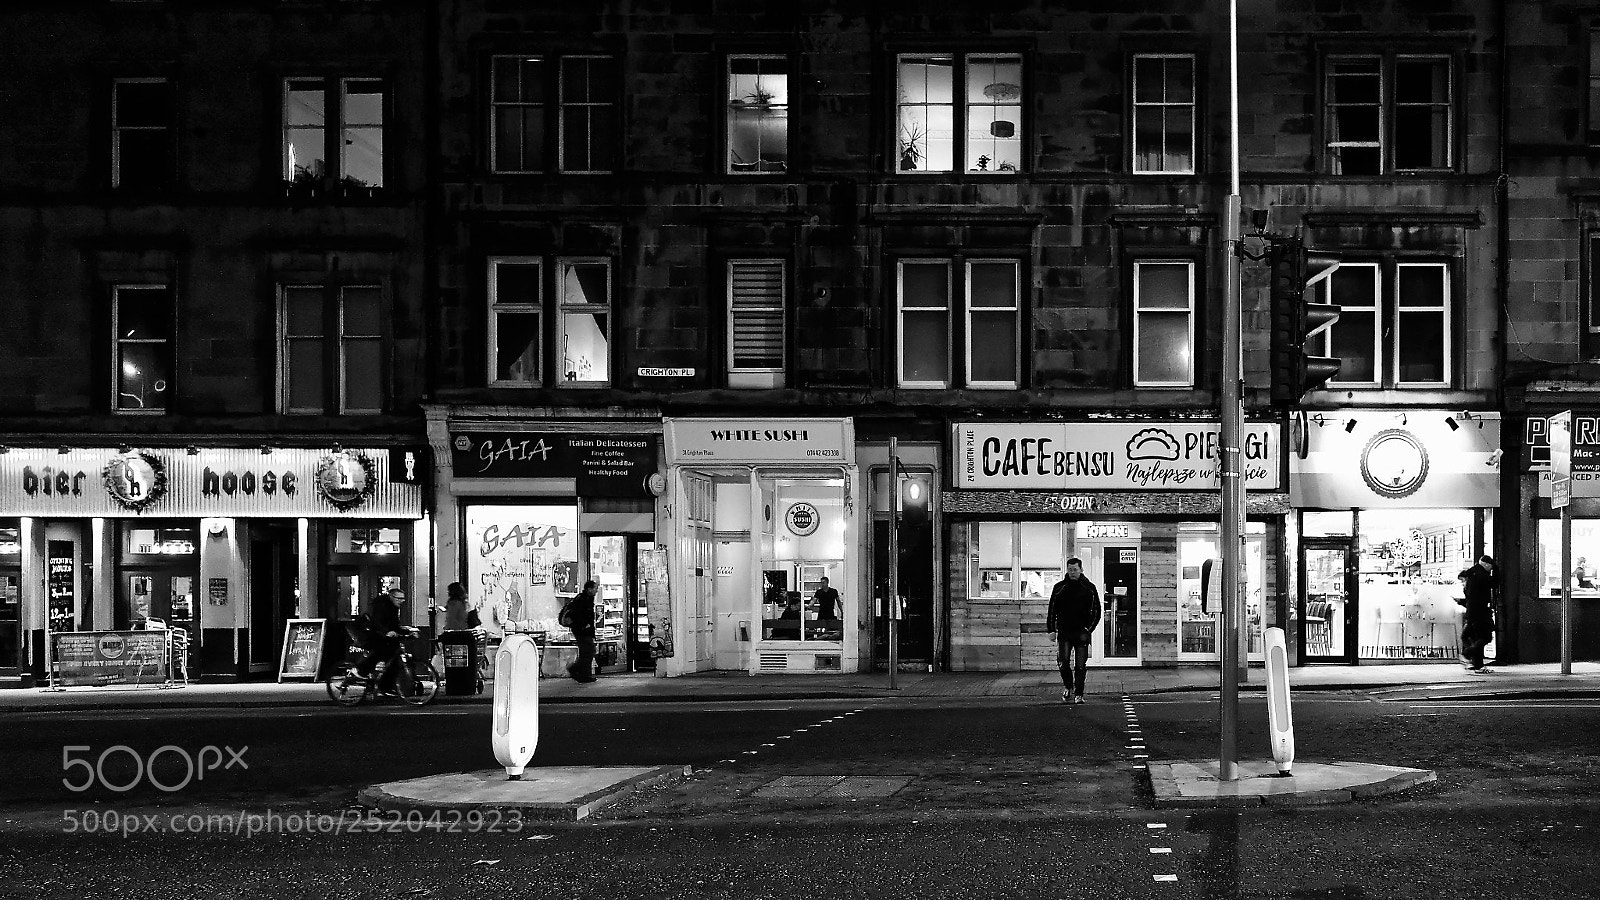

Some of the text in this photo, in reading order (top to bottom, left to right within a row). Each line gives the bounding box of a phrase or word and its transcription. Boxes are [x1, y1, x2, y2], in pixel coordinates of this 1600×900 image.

[568, 439, 647, 448] Italian Delicatessen
[710, 429, 809, 441] WHITE SUSHI
[1575, 417, 1600, 445] R
[478, 437, 553, 473] GAIA
[982, 436, 1053, 477] CAFE
[1184, 431, 1268, 460] PIEGI
[1573, 449, 1593, 458] Mac
[23, 465, 87, 498] bier
[201, 466, 296, 499] hoose
[588, 469, 612, 477] Healthy
[1126, 460, 1197, 486] Najlepsze
[1060, 496, 1093, 510] OPEN
[480, 524, 566, 557] GAIA
[1088, 525, 1126, 537] OPEN
